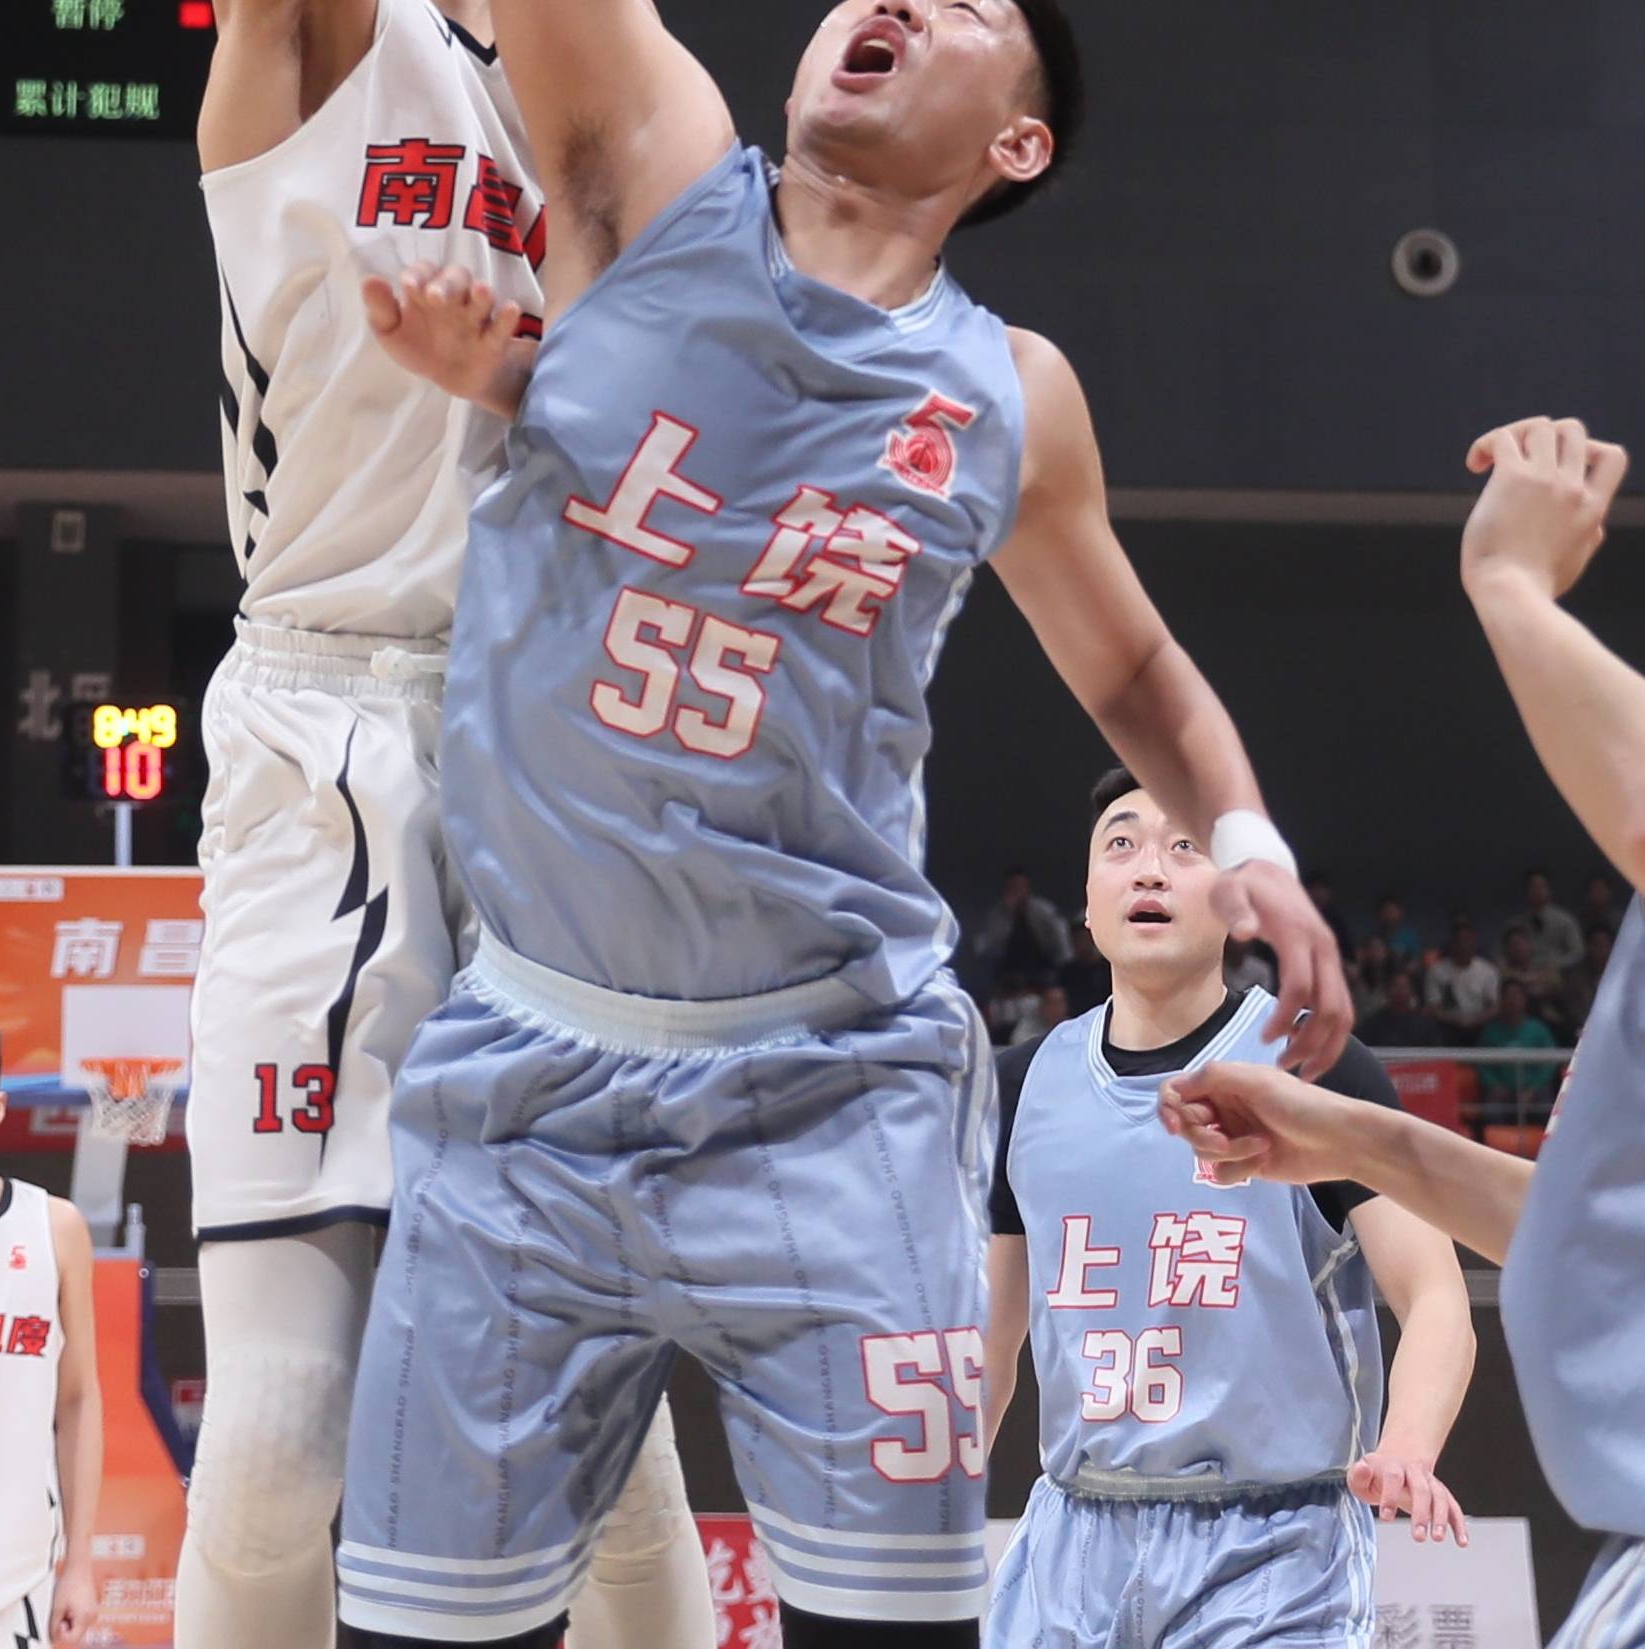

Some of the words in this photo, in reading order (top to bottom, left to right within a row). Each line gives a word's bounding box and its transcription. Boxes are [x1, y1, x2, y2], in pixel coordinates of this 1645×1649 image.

[16, 80, 159, 119] 累计犯规
[563, 409, 922, 638] 上饶
[588, 586, 782, 760] 55
[93, 704, 177, 748] 8:49
[105, 742, 162, 800] 10
[49, 917, 207, 979] 南昌
[253, 1061, 338, 1134] 13
[1045, 1211, 1247, 1310] 上饶
[1081, 1324, 1184, 1423] 36
